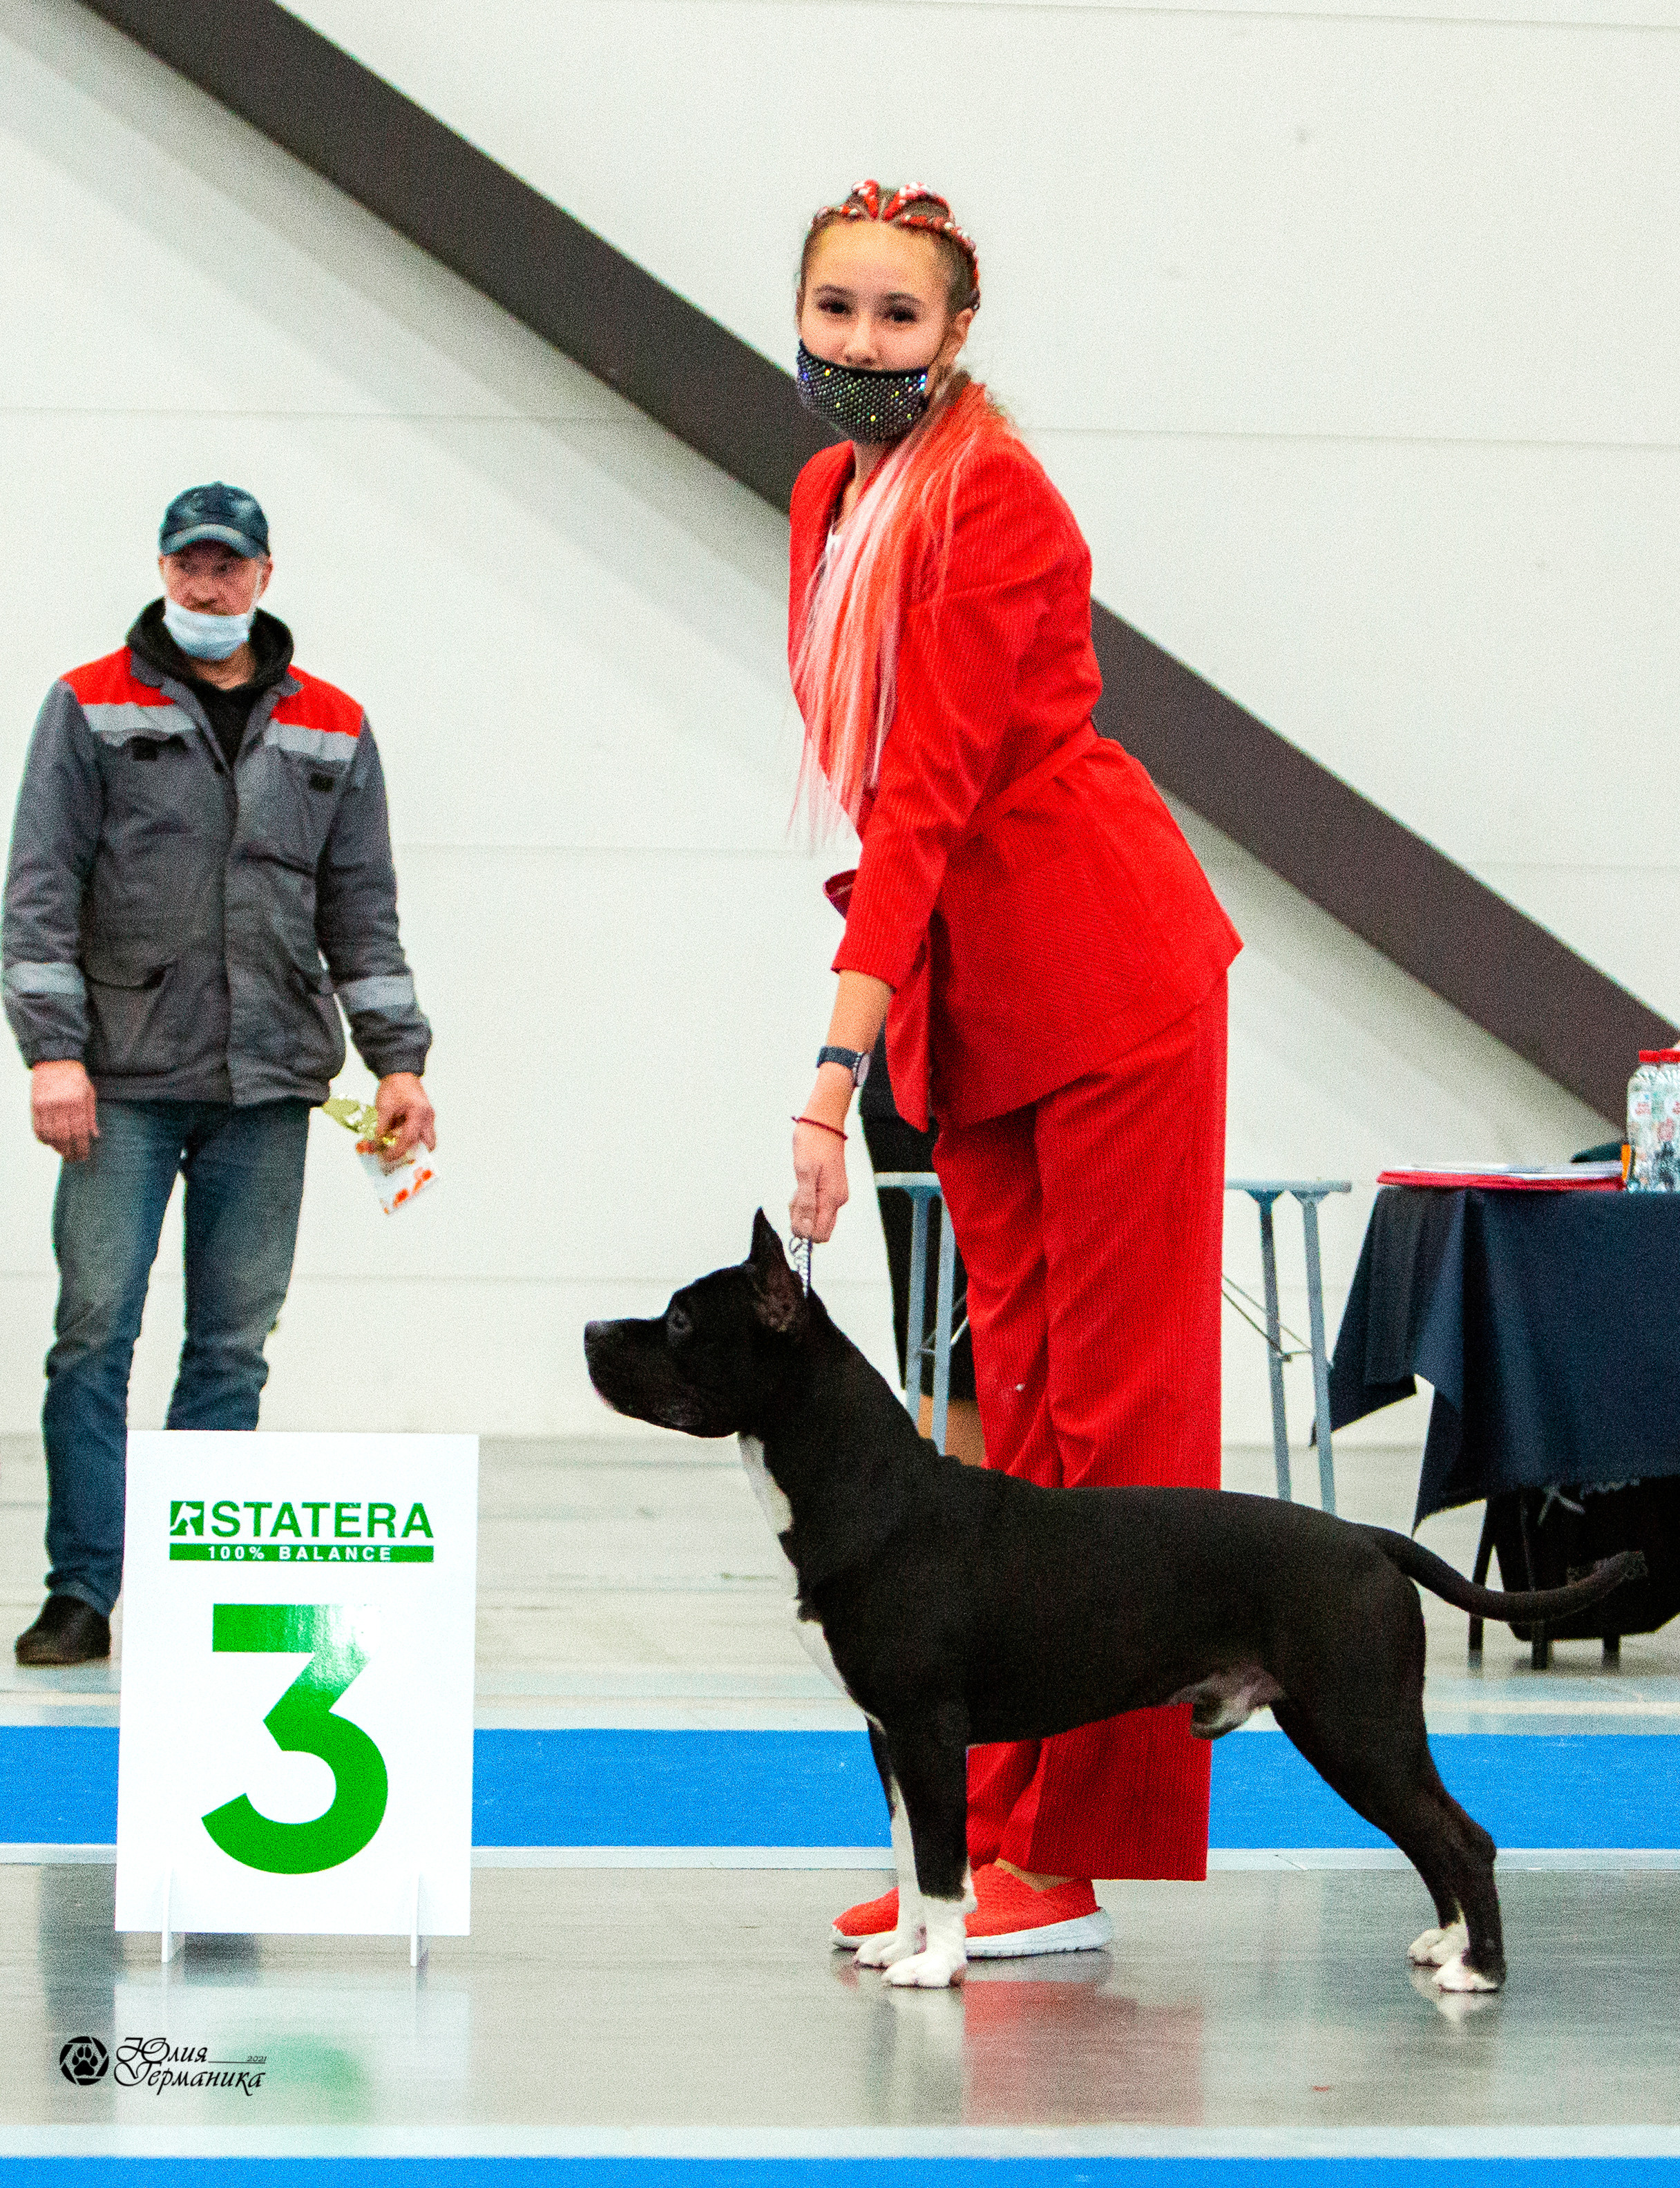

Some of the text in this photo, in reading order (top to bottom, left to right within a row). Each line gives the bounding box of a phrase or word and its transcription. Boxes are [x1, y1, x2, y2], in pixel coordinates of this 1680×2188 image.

[211, 1501, 434, 1539] STATERA
[208, 1545, 392, 1561] 100% BALANCE
[202, 1604, 388, 1874] 3
